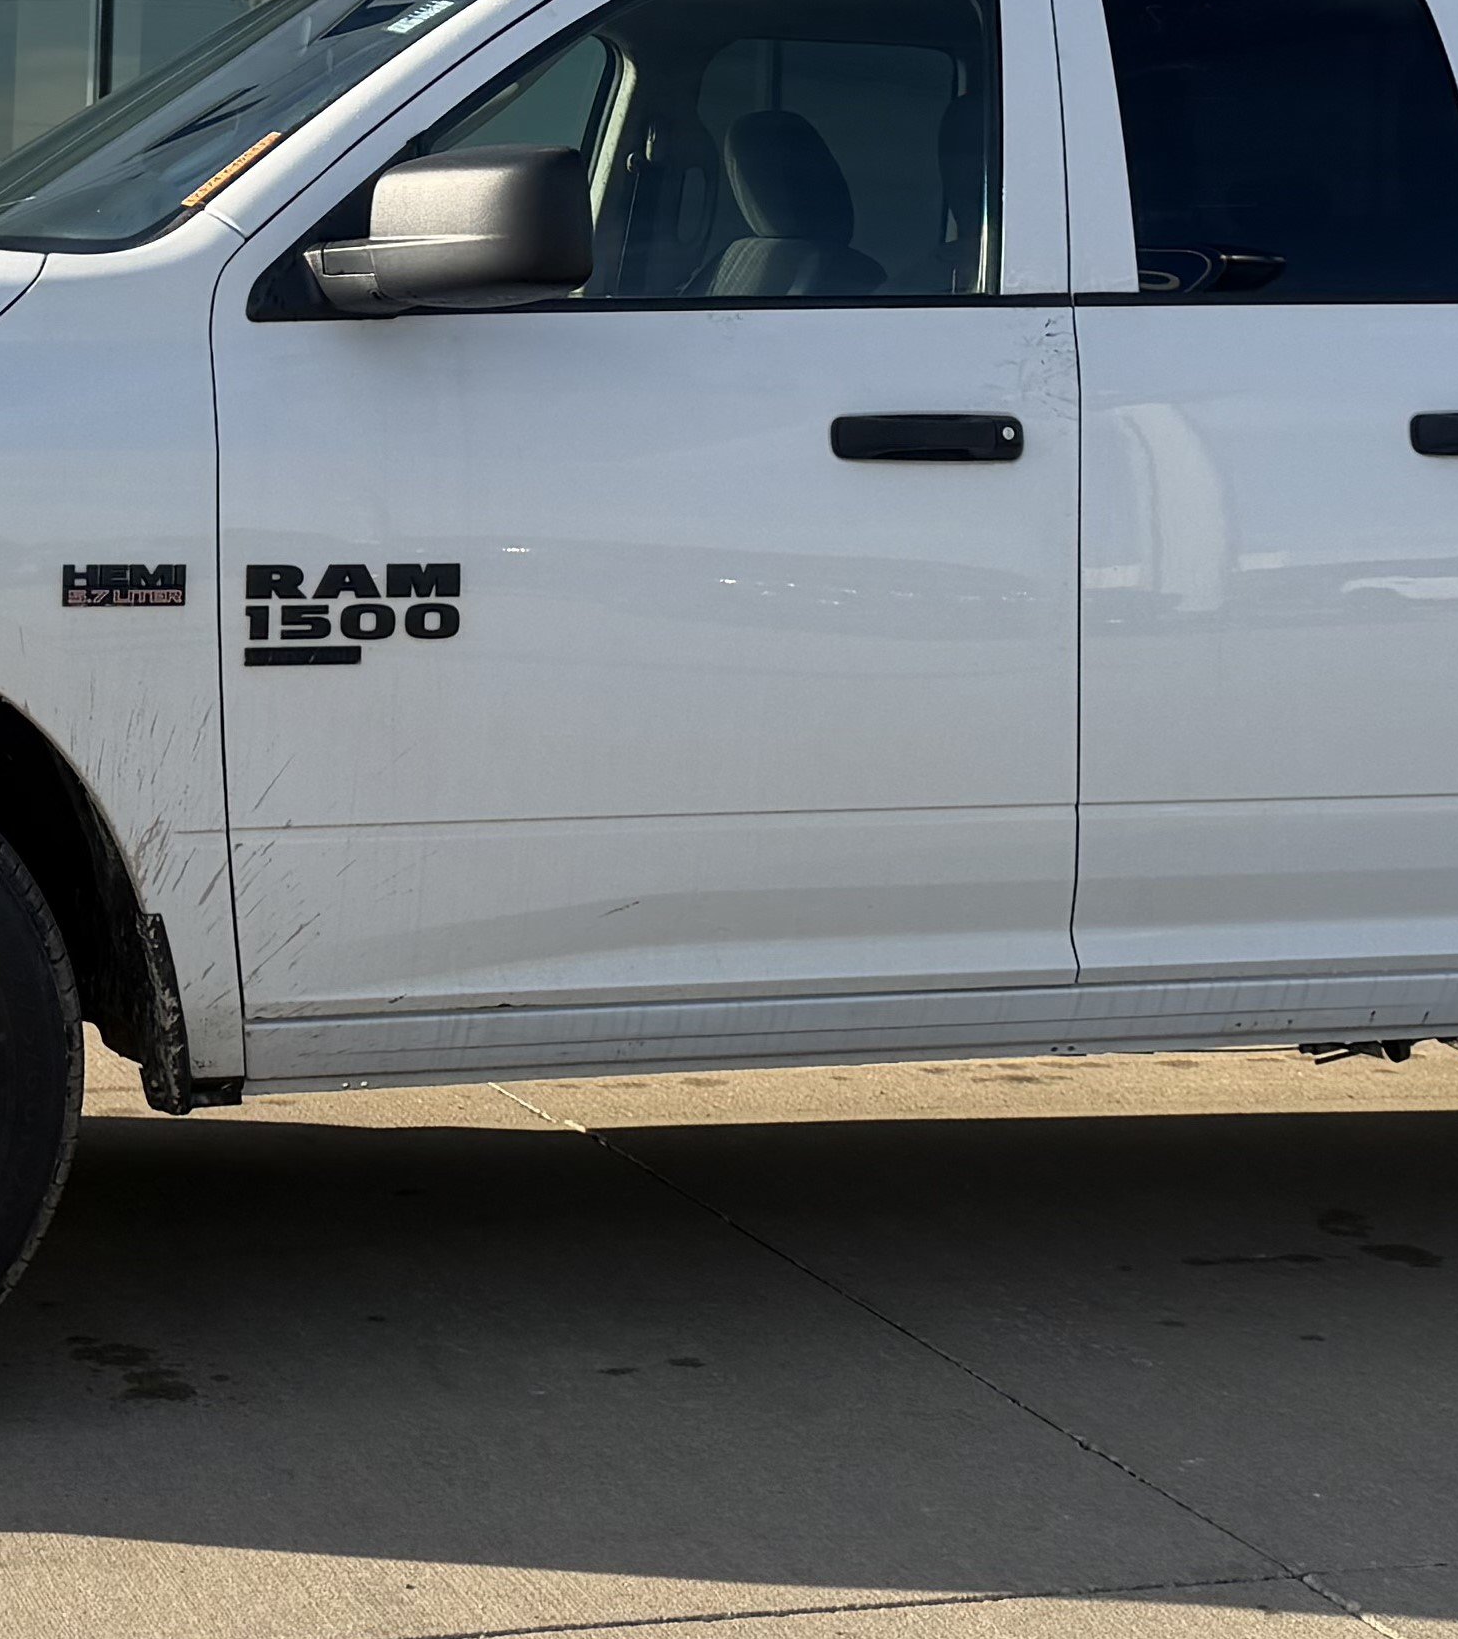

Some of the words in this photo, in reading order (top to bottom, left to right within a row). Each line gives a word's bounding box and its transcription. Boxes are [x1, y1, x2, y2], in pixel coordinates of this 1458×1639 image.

[63, 564, 186, 587] HEMI
[245, 563, 461, 599] RAM
[67, 588, 110, 604] 5.7
[112, 588, 183, 604] LITER
[245, 603, 461, 640] 1500
